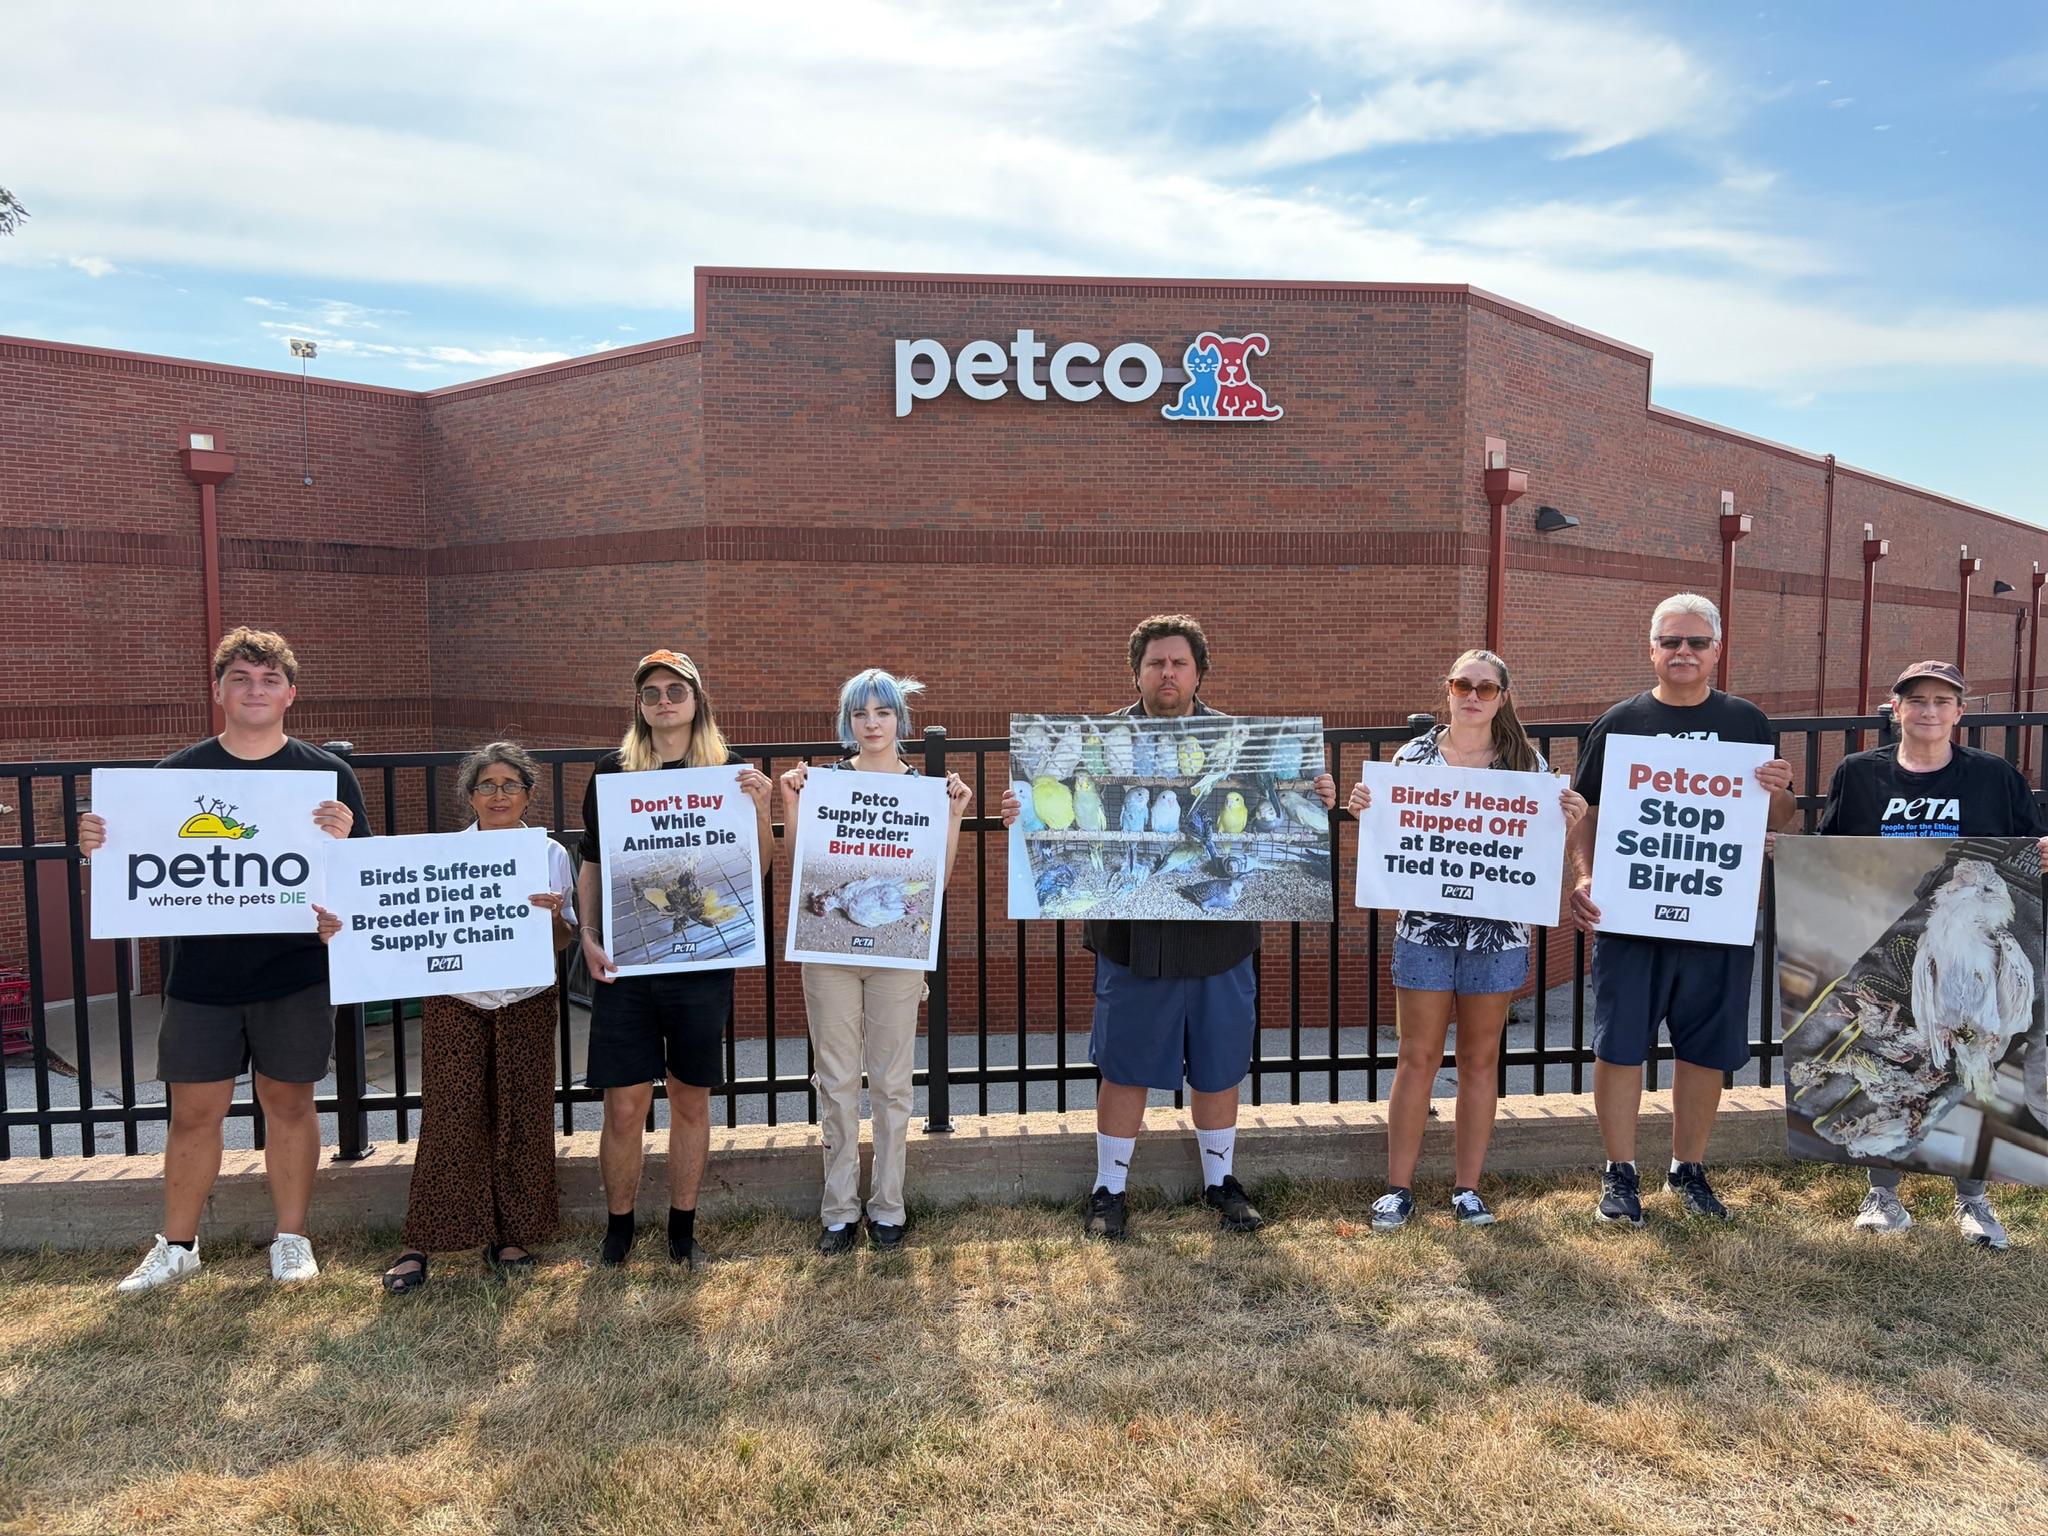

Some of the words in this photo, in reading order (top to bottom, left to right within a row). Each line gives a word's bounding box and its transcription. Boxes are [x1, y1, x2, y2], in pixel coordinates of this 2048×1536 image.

[896, 329, 1163, 417] petco
[1629, 764, 1742, 798] Petco:
[687, 794, 723, 810] Buy
[852, 792, 899, 807] Petco
[1465, 792, 1538, 815] Heads
[651, 813, 706, 831] While
[817, 806, 878, 825] Supply
[882, 811, 929, 826] Chain
[1400, 810, 1482, 833] Ripped
[1489, 817, 1527, 837] Off
[1638, 798, 1724, 835] Stop
[1881, 823, 1904, 831] People
[1906, 823, 1918, 831] for
[1920, 822, 1932, 830] the
[1934, 822, 1959, 831] Ethical
[623, 832, 701, 851] Animals
[706, 830, 736, 845] Die
[837, 824, 909, 843] Breeder:
[829, 841, 864, 855] Bird
[869, 843, 913, 858] Killer
[1400, 835, 1424, 851] at
[1430, 835, 1523, 860] Breeder
[1616, 830, 1742, 871] Selling
[128, 845, 309, 900] petno
[360, 866, 418, 886] Birds
[423, 859, 516, 881] Suffered
[1384, 855, 1434, 875] Tied
[1440, 859, 1463, 878] to
[1470, 861, 1536, 886] Petco
[2003, 856, 2043, 878] UALITY
[1629, 863, 1723, 897] Birds
[149, 894, 202, 906] where
[207, 893, 235, 905] the
[240, 893, 275, 907] pets
[280, 892, 305, 904] DIE
[379, 888, 420, 906] and
[426, 884, 474, 903] Died
[480, 883, 501, 899] at
[352, 909, 439, 931] Breeder
[444, 907, 464, 924] in
[470, 904, 529, 921] Petco
[371, 930, 447, 952] Supply
[453, 925, 514, 944] Chain
